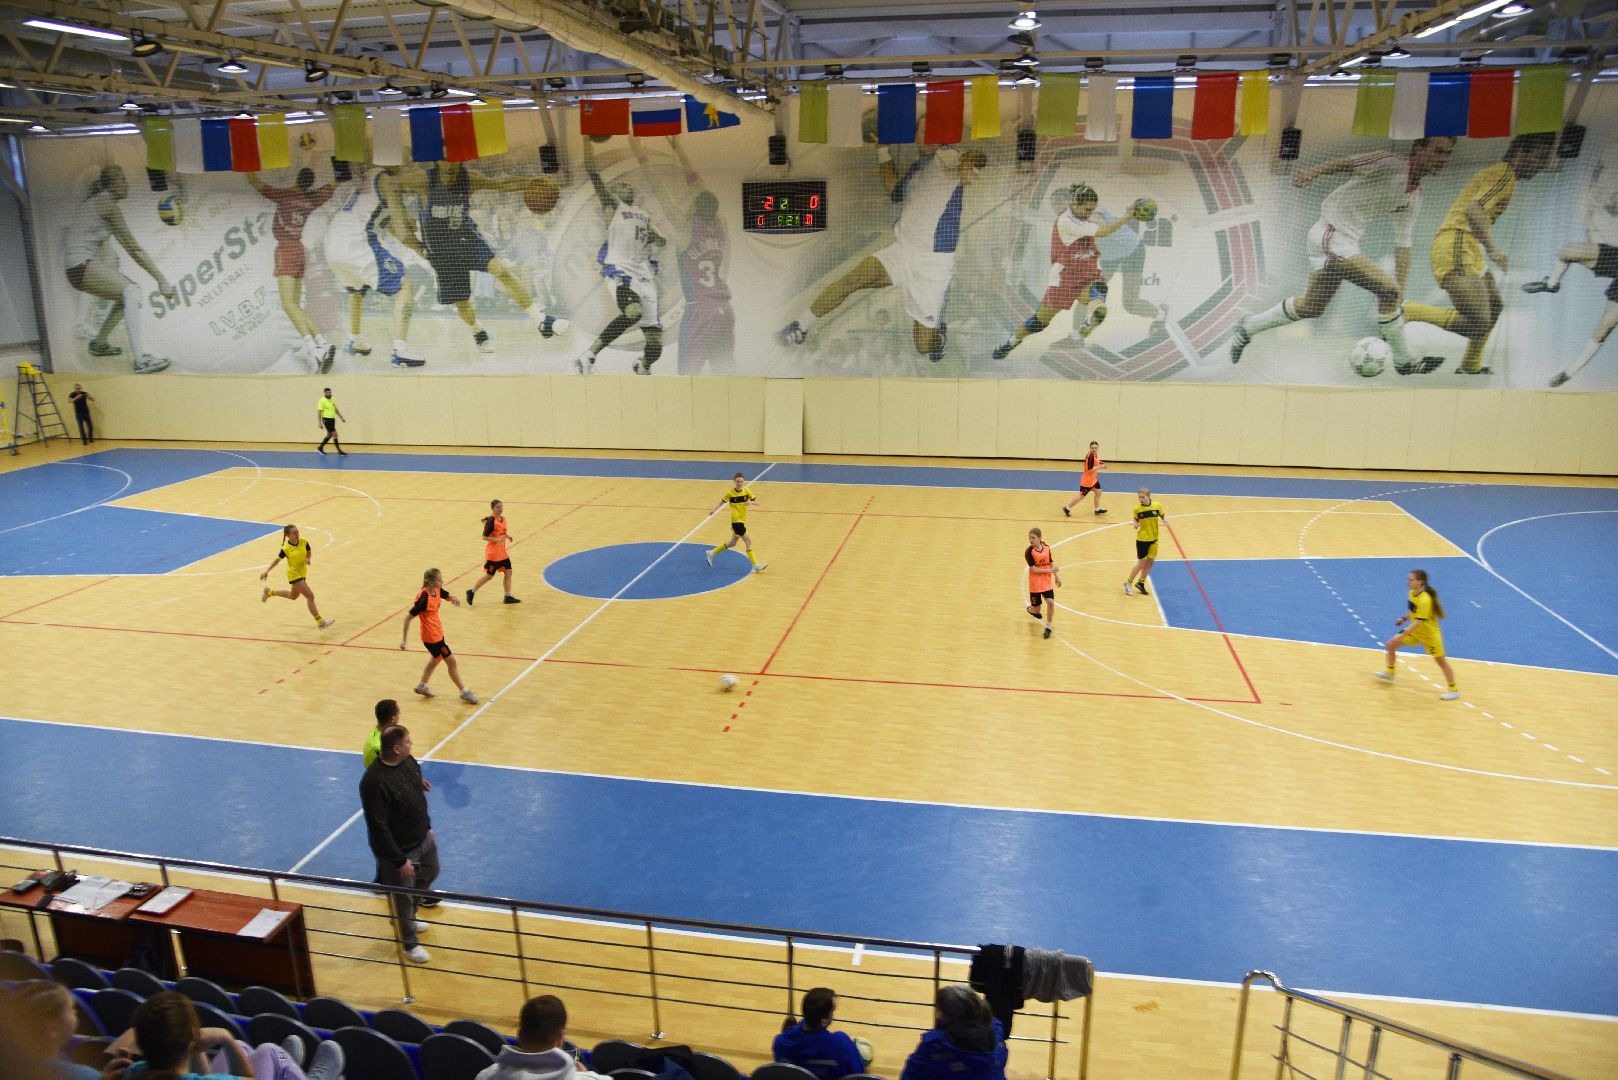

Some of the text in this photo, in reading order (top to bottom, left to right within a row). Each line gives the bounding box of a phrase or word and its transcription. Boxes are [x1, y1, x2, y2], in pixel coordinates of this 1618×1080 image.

[764, 194, 819, 211] 2 2 0
[757, 214, 765, 226] 0
[698, 260, 715, 287] 3
